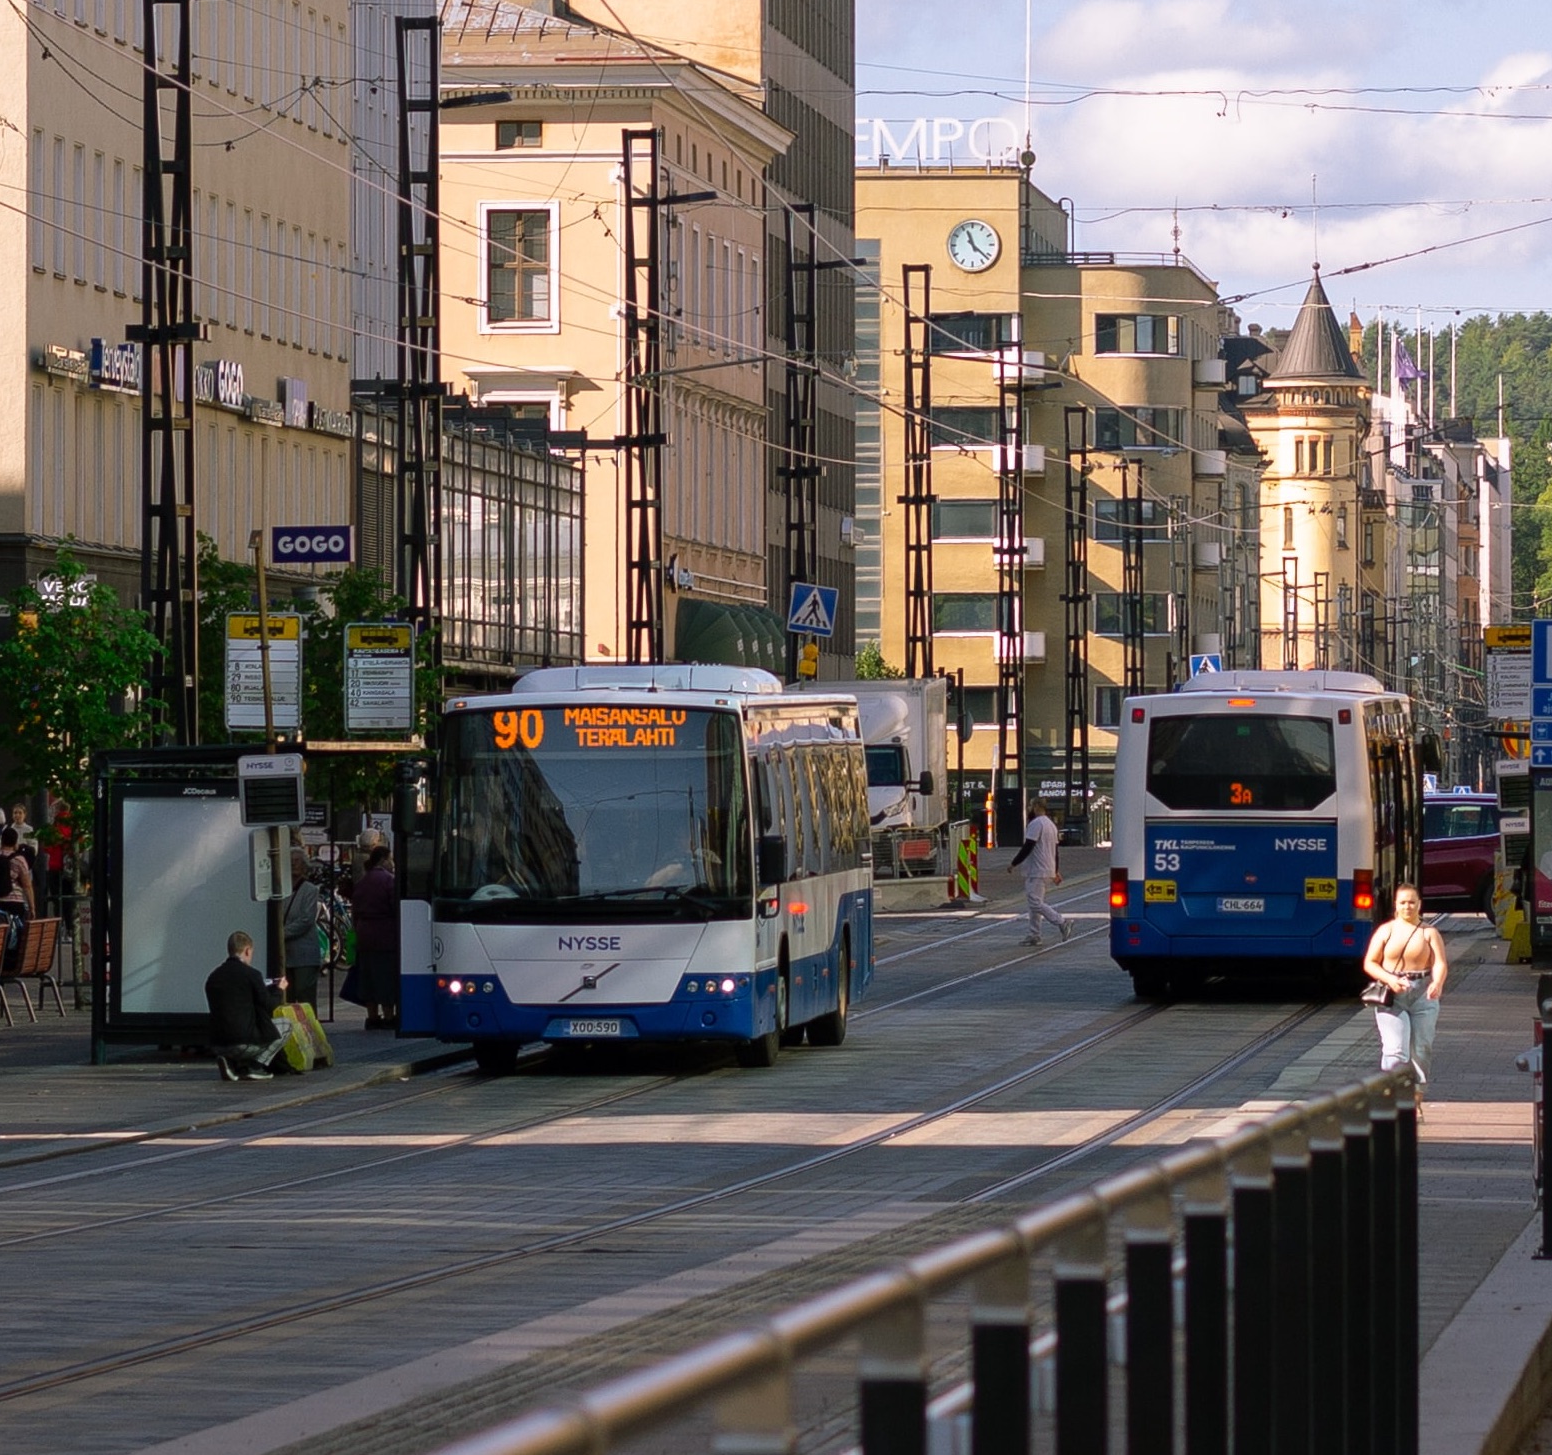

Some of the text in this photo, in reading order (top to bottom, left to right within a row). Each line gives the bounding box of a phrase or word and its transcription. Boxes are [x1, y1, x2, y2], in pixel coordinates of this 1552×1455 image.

[218, 359, 245, 407] GOGO
[277, 535, 345, 554] GOGO
[234, 662, 240, 671] 8
[353, 659, 358, 668] 3
[230, 673, 241, 682] 29
[350, 669, 359, 678] 17
[230, 683, 241, 693] 80
[349, 679, 361, 688] 20
[350, 688, 362, 697] 40
[230, 694, 242, 703] 90
[349, 698, 360, 707] 42
[493, 709, 545, 749] 90
[246, 761, 274, 770] NYSSE
[1230, 782, 1253, 805] 3A
[1154, 840, 1180, 851] TKL
[1274, 838, 1327, 851] NYSSE
[1154, 853, 1181, 872] 53
[1223, 900, 1263, 911] CHL-664
[558, 936, 621, 951] NYSSE
